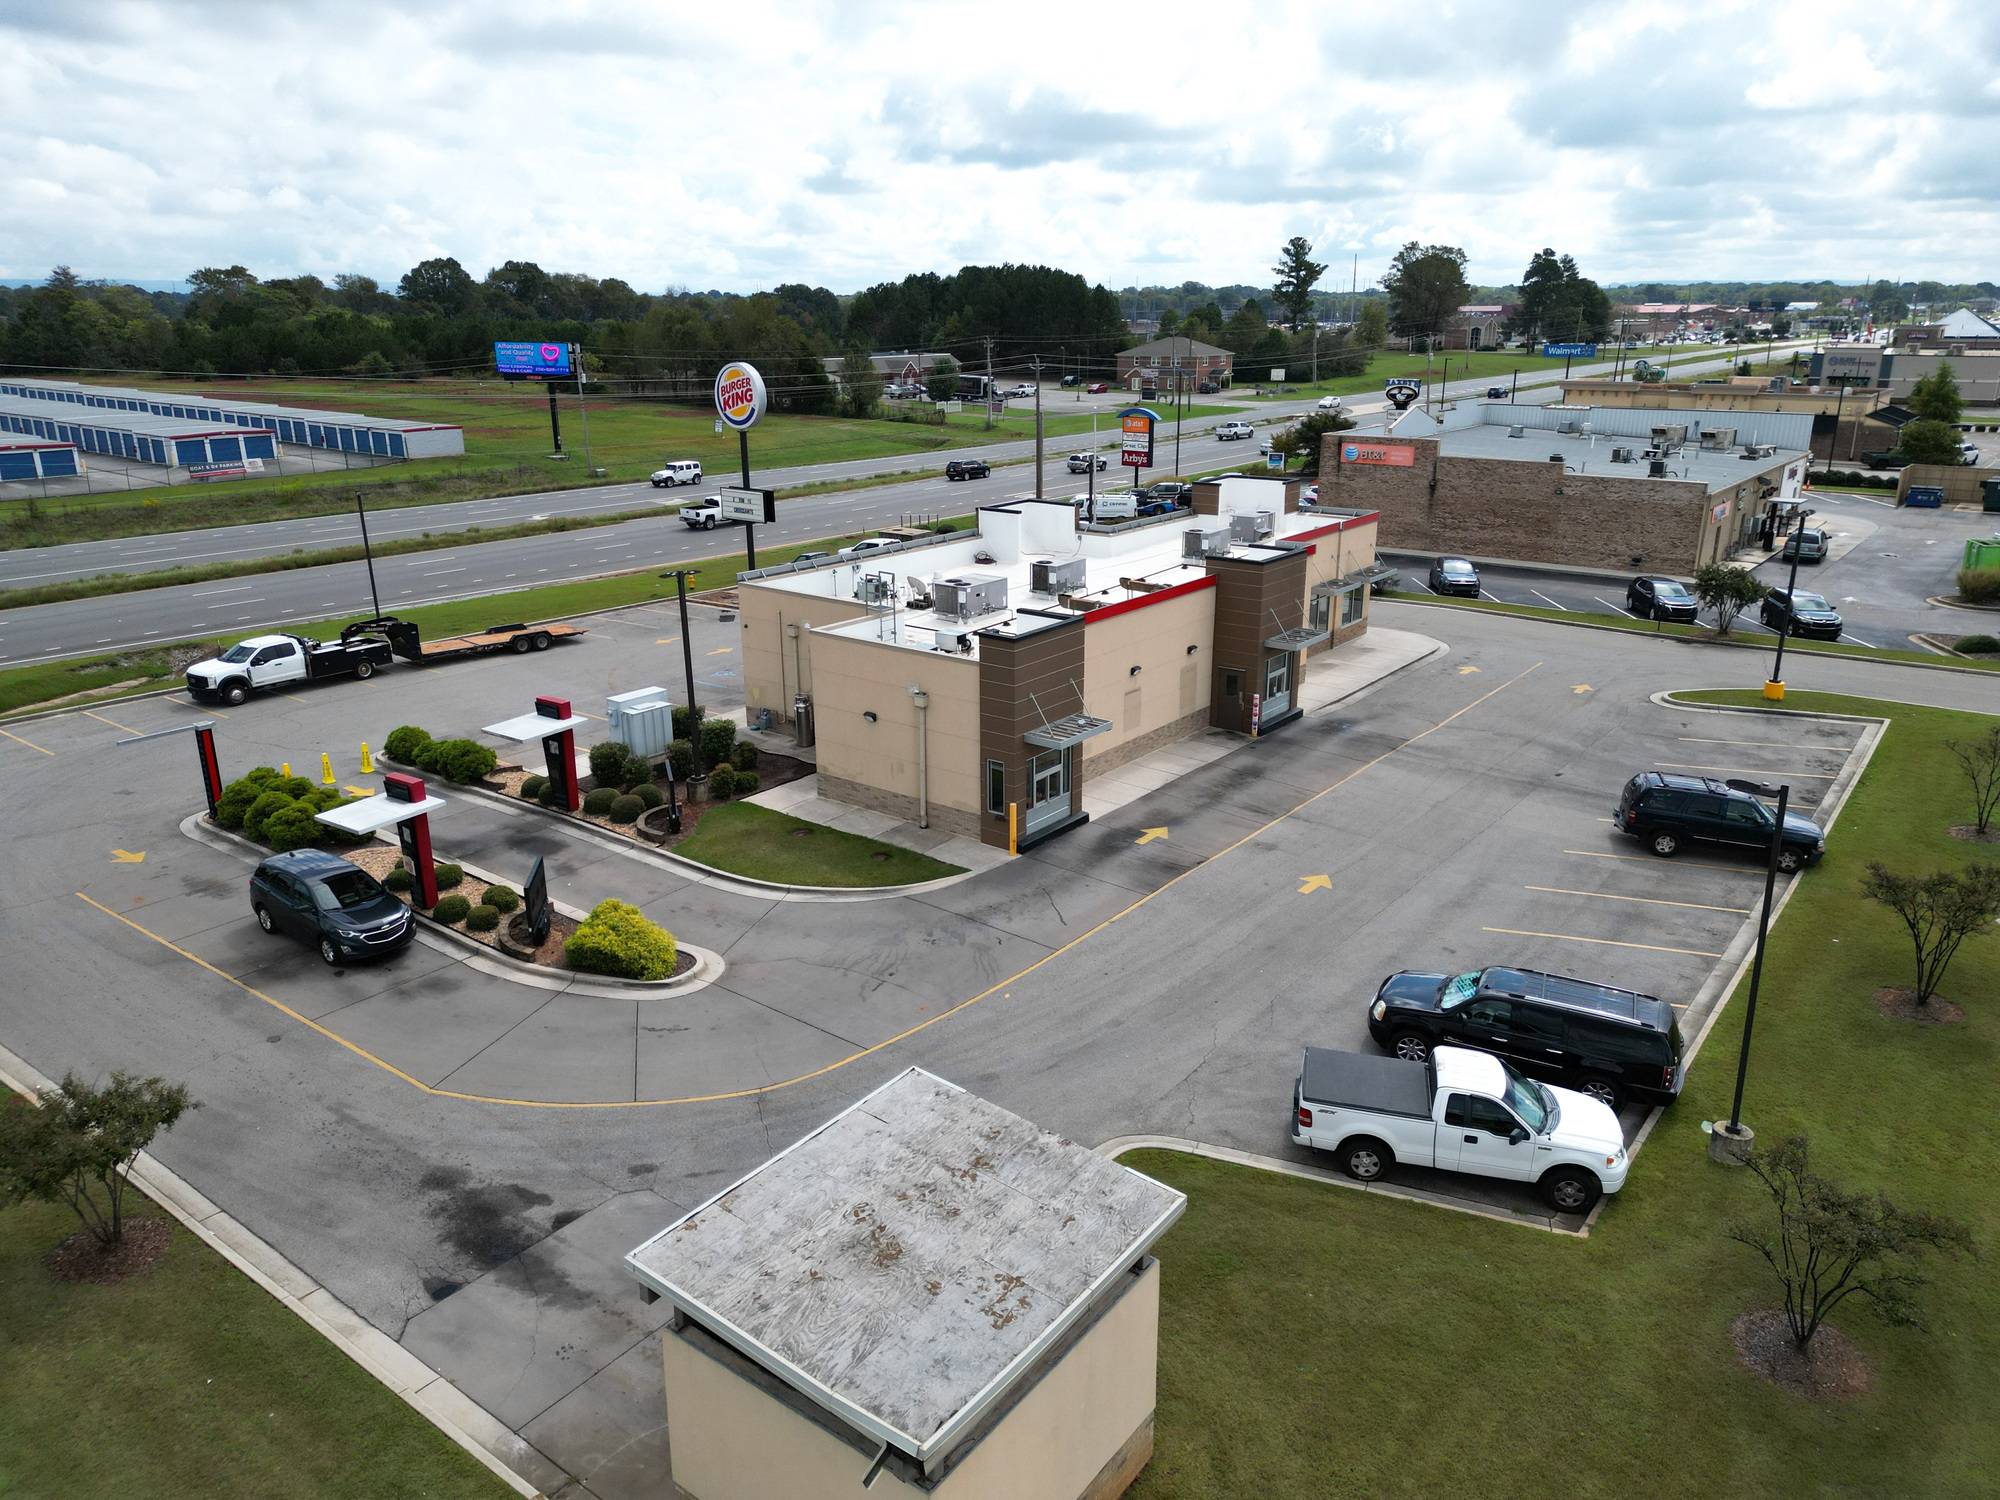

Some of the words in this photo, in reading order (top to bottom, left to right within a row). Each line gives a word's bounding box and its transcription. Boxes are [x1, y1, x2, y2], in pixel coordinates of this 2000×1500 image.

[1548, 346, 1581, 355] Walmart
[720, 377, 752, 397] BURGER
[722, 388, 754, 412] KING
[1123, 453, 1148, 465] Arby's
